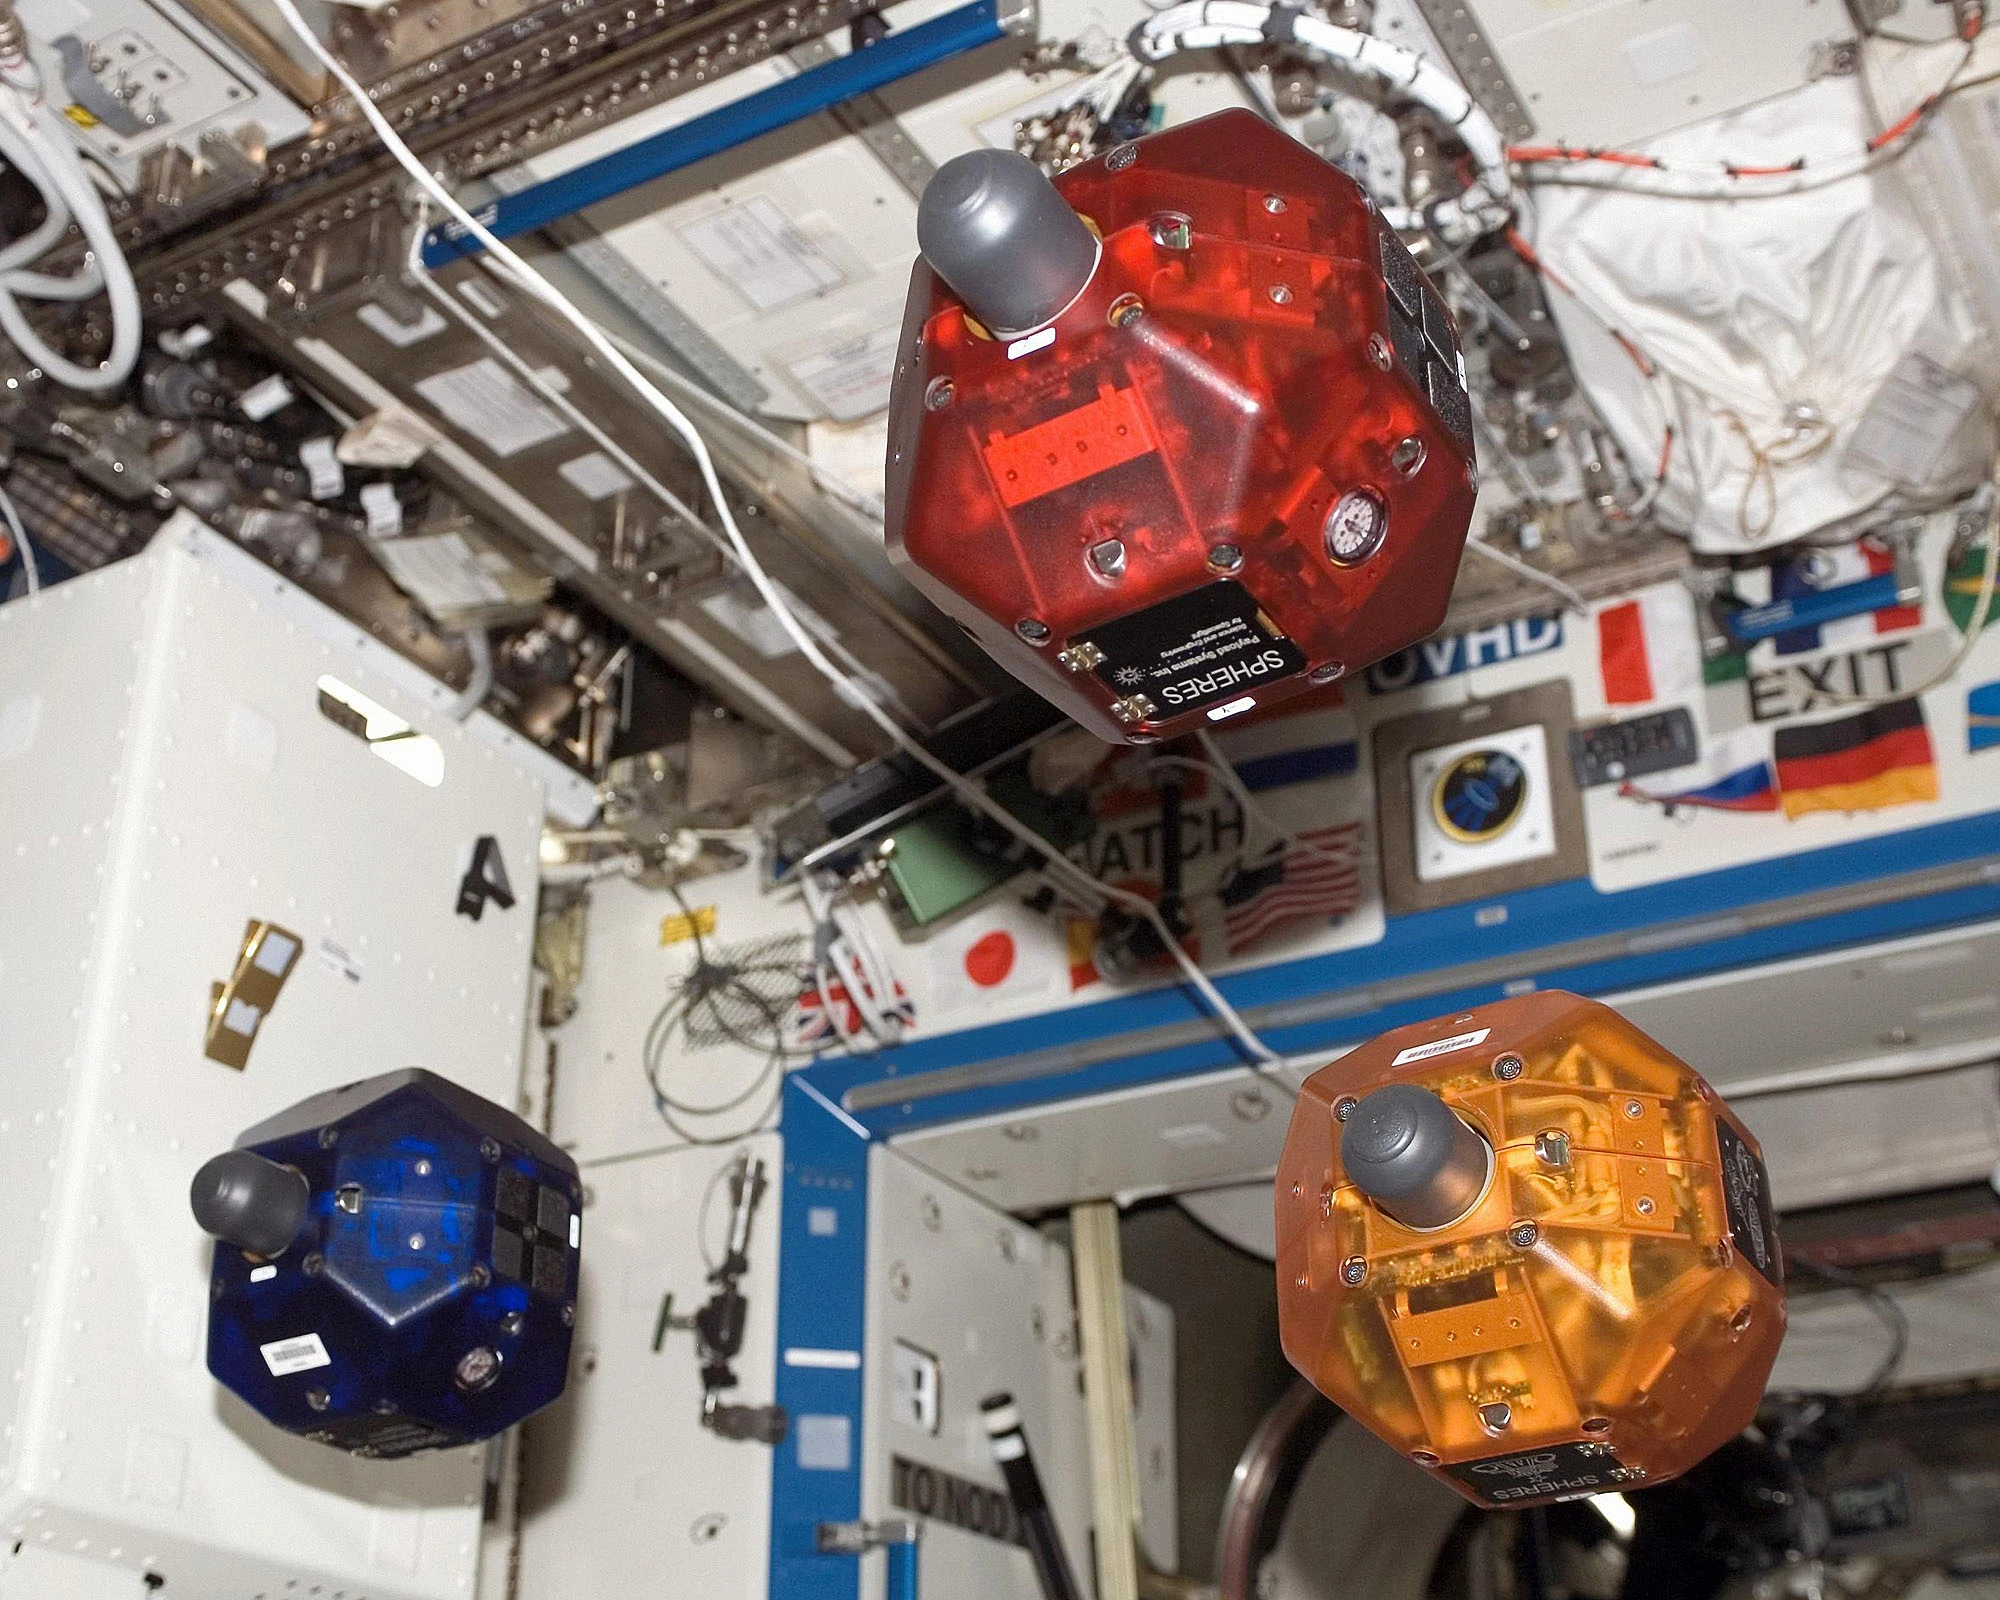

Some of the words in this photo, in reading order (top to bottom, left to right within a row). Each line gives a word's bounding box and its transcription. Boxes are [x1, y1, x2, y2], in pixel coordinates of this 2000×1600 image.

[1171, 651, 1217, 671] Systems
[1216, 635, 1260, 656] Payload
[1162, 649, 1284, 705] SPHERES
[1748, 638, 1911, 723] EXIT
[1066, 807, 1246, 878] ATCH
[945, 1474, 1028, 1547] NOD
[1493, 1475, 1600, 1499] SPHERES
